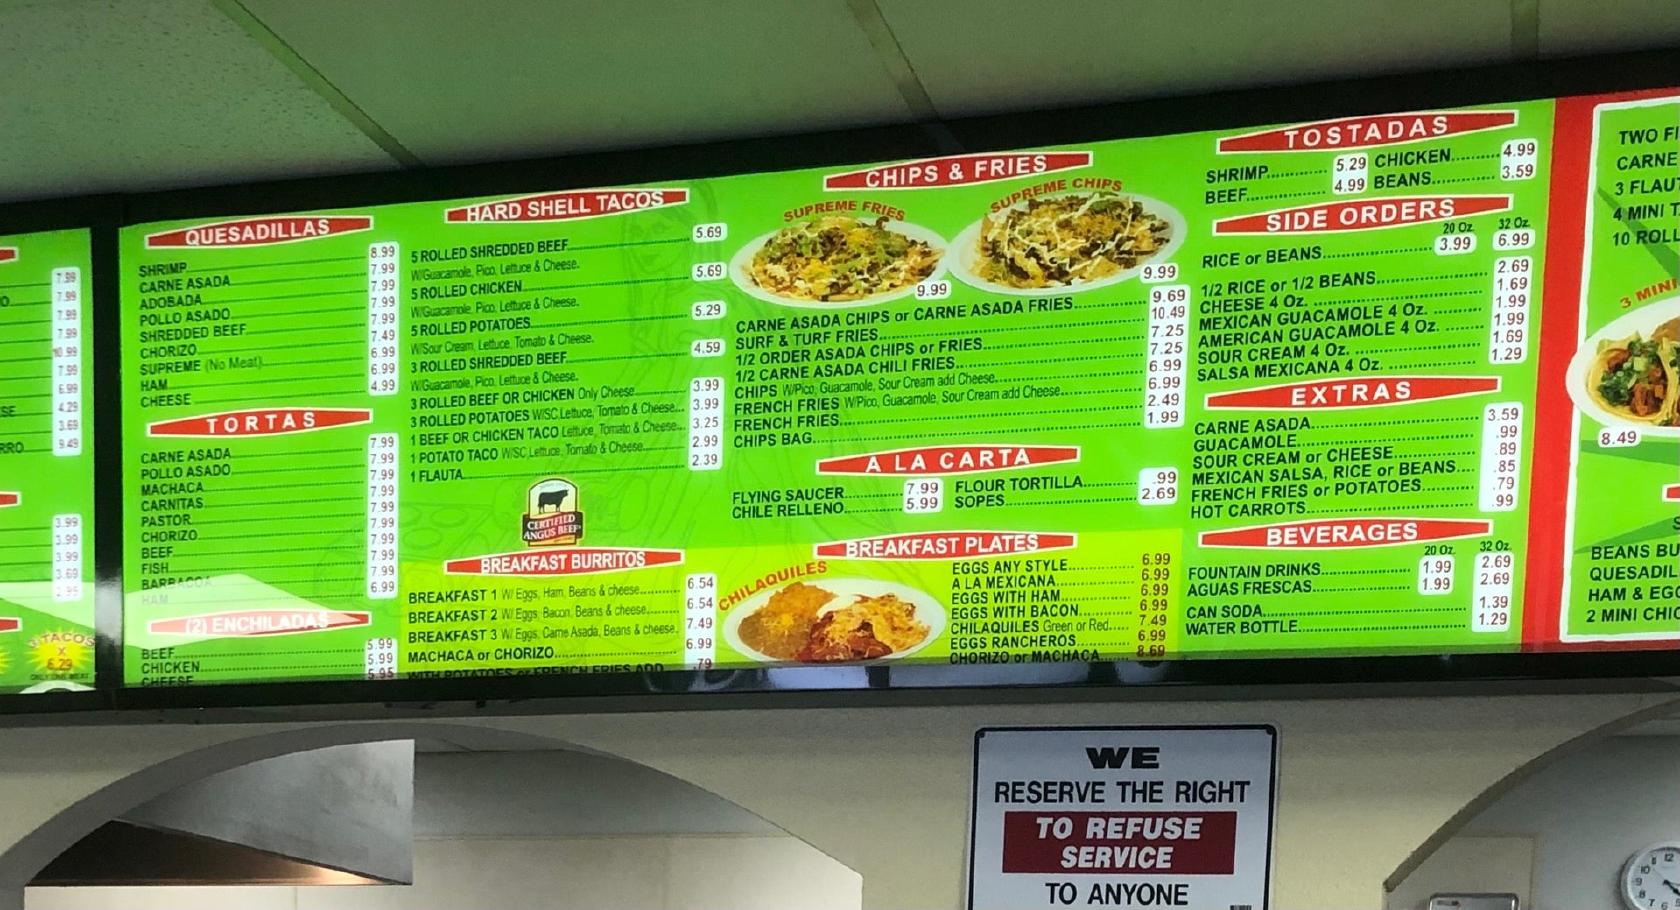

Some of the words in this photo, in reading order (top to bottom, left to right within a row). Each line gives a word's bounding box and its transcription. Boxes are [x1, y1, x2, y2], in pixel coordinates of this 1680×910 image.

[1285, 116, 1448, 148] TOSTADAS
[1619, 129, 1658, 145] TWO
[1375, 149, 1451, 168] CHICKEN
[1504, 143, 1535, 157] 4.99
[1617, 152, 1677, 170] CARNE
[866, 165, 937, 188] CHIPS
[949, 163, 963, 180] &
[975, 155, 1047, 178] FRIES
[1206, 166, 1268, 183] SHRIMP
[1336, 158, 1366, 172] 5.29
[1374, 172, 1432, 189] BEANS
[1502, 164, 1533, 178] 3.59
[990, 179, 1066, 214] SUPREME
[1071, 178, 1122, 192] CHIPS
[1615, 182, 1623, 196] 3
[467, 201, 522, 222] HARD
[527, 198, 590, 217] SHELL
[597, 192, 663, 211] TACOS
[783, 201, 857, 222] SUPREME
[862, 201, 906, 221] FRIES
[1266, 209, 1328, 231] SIDE
[1339, 199, 1455, 224] ORDERS
[1613, 207, 1622, 221] 4
[1628, 204, 1664, 220] MINI
[1671, 203, 1680, 216] T
[185, 219, 330, 246] QUESADILLAS
[1444, 223, 1454, 234] 20
[1499, 219, 1510, 230] 32
[411, 252, 417, 263] 5
[420, 248, 467, 262] ROLLED
[470, 242, 534, 257] SHREDDED
[538, 239, 568, 252] BEEF
[696, 227, 722, 239] 5.69
[1203, 253, 1240, 268] RICE
[1245, 253, 1261, 265] or
[1266, 246, 1322, 263] BEANS
[1440, 237, 1471, 251] 3.99
[1499, 232, 1529, 246] 6.99
[1613, 232, 1629, 246] 10
[139, 262, 187, 277] SHRIMP
[370, 247, 395, 258] 8.99
[1144, 265, 1176, 280] 9.99
[139, 279, 182, 294] CARNE
[186, 275, 231, 290] ASADA
[917, 283, 947, 296] 9.99
[1620, 297, 1631, 308] 3
[1636, 278, 1678, 302] MINI
[139, 294, 202, 310] ADOBADA
[1200, 298, 1264, 314] CHEESE
[1269, 296, 1278, 308] 4
[1283, 294, 1308, 308] Oz.
[1497, 278, 1527, 291] 1.69
[736, 319, 786, 334] CARNE
[790, 314, 842, 329] ASADA
[845, 310, 890, 325] CHIPS
[895, 310, 907, 322] or
[913, 305, 967, 321] CARNE
[971, 300, 1024, 316] ASADA
[1028, 297, 1073, 313] FRIES
[1153, 289, 1185, 303] 9.69
[140, 344, 197, 359] CHORIZO
[371, 330, 395, 341] 7.49
[140, 361, 200, 376] SUPREME
[205, 358, 226, 372] (No
[227, 356, 263, 371] Meat)
[734, 384, 778, 398] CHIPS
[878, 376, 900, 390] Sour
[903, 373, 934, 388] Cream
[937, 372, 955, 385] add
[1149, 358, 1181, 373] 6.99
[141, 394, 191, 408] CHEESE
[1291, 381, 1411, 405] EXTRAS
[206, 412, 316, 434] TORTAS
[734, 434, 778, 448] CHIPS
[782, 431, 812, 445] BAG
[1147, 410, 1179, 424] 1.99
[1193, 434, 1297, 452] GUACAMOLE
[1496, 425, 1517, 438] .99
[1601, 431, 1637, 445] 8.49
[411, 471, 415, 482] 1
[419, 469, 463, 482] FLAUTA
[692, 454, 718, 466] 2.39
[865, 455, 881, 472] A
[894, 452, 926, 470] LA
[939, 449, 1030, 469] CARTA
[141, 482, 203, 496] MACHACA
[733, 490, 781, 504] FLYING
[786, 486, 843, 501] SAUCER
[907, 482, 938, 495] 7.99
[955, 479, 1005, 493] FLOUR
[1007, 475, 1083, 489] TORTILLA
[1191, 505, 1223, 519] HOT
[1228, 502, 1306, 516] CARROTS
[1492, 495, 1514, 508] .99
[141, 515, 191, 527] PASTOR
[527, 514, 575, 529] CERTIFIED
[524, 528, 556, 540] ANGUS
[846, 537, 959, 557] BREAKFAST
[965, 533, 1038, 554] PLATES
[1267, 523, 1417, 546] BEVERAGES
[481, 555, 565, 574] BREAKFAST
[571, 551, 645, 569] BURRITOS
[1591, 544, 1650, 560] BEANS
[142, 563, 169, 574] FISH
[1189, 565, 1261, 579] FOUNTAIN
[1266, 563, 1321, 577] DRINKS
[1423, 560, 1451, 574] 1.99
[1482, 556, 1511, 569] 2.69
[409, 590, 487, 605] BREAKFAST
[492, 590, 496, 601] 1
[569, 586, 596, 597] Beans
[599, 585, 605, 596] &
[688, 577, 713, 589] 6.54
[718, 560, 828, 612] CHILAQUILES
[1588, 588, 1626, 601] HAM
[1633, 587, 1643, 600] &
[186, 617, 208, 634] (2)
[213, 612, 329, 633] ENCHILADAS
[951, 619, 1039, 634] CHILAQUILES
[1043, 619, 1073, 632] Green
[1076, 619, 1086, 631] or
[1089, 617, 1109, 631] Red
[1139, 614, 1167, 627] 7.49
[1587, 610, 1595, 622] 2
[1602, 609, 1637, 622] MINI
[41, 633, 95, 646] TACOS
[142, 661, 200, 674] CHICKEN
[1086, 747, 1160, 768] WE
[995, 781, 1105, 803] RESERVE
[1116, 781, 1163, 803] THE
[1176, 781, 1250, 802] RIGHT
[1037, 818, 1072, 839] TO
[1086, 817, 1203, 839] REFUSE
[1061, 846, 1173, 868] SERVICE
[1665, 853, 1674, 862] 12
[1641, 866, 1650, 874] 10
[1046, 884, 1077, 905] TO
[1088, 884, 1189, 905] ANYONE
